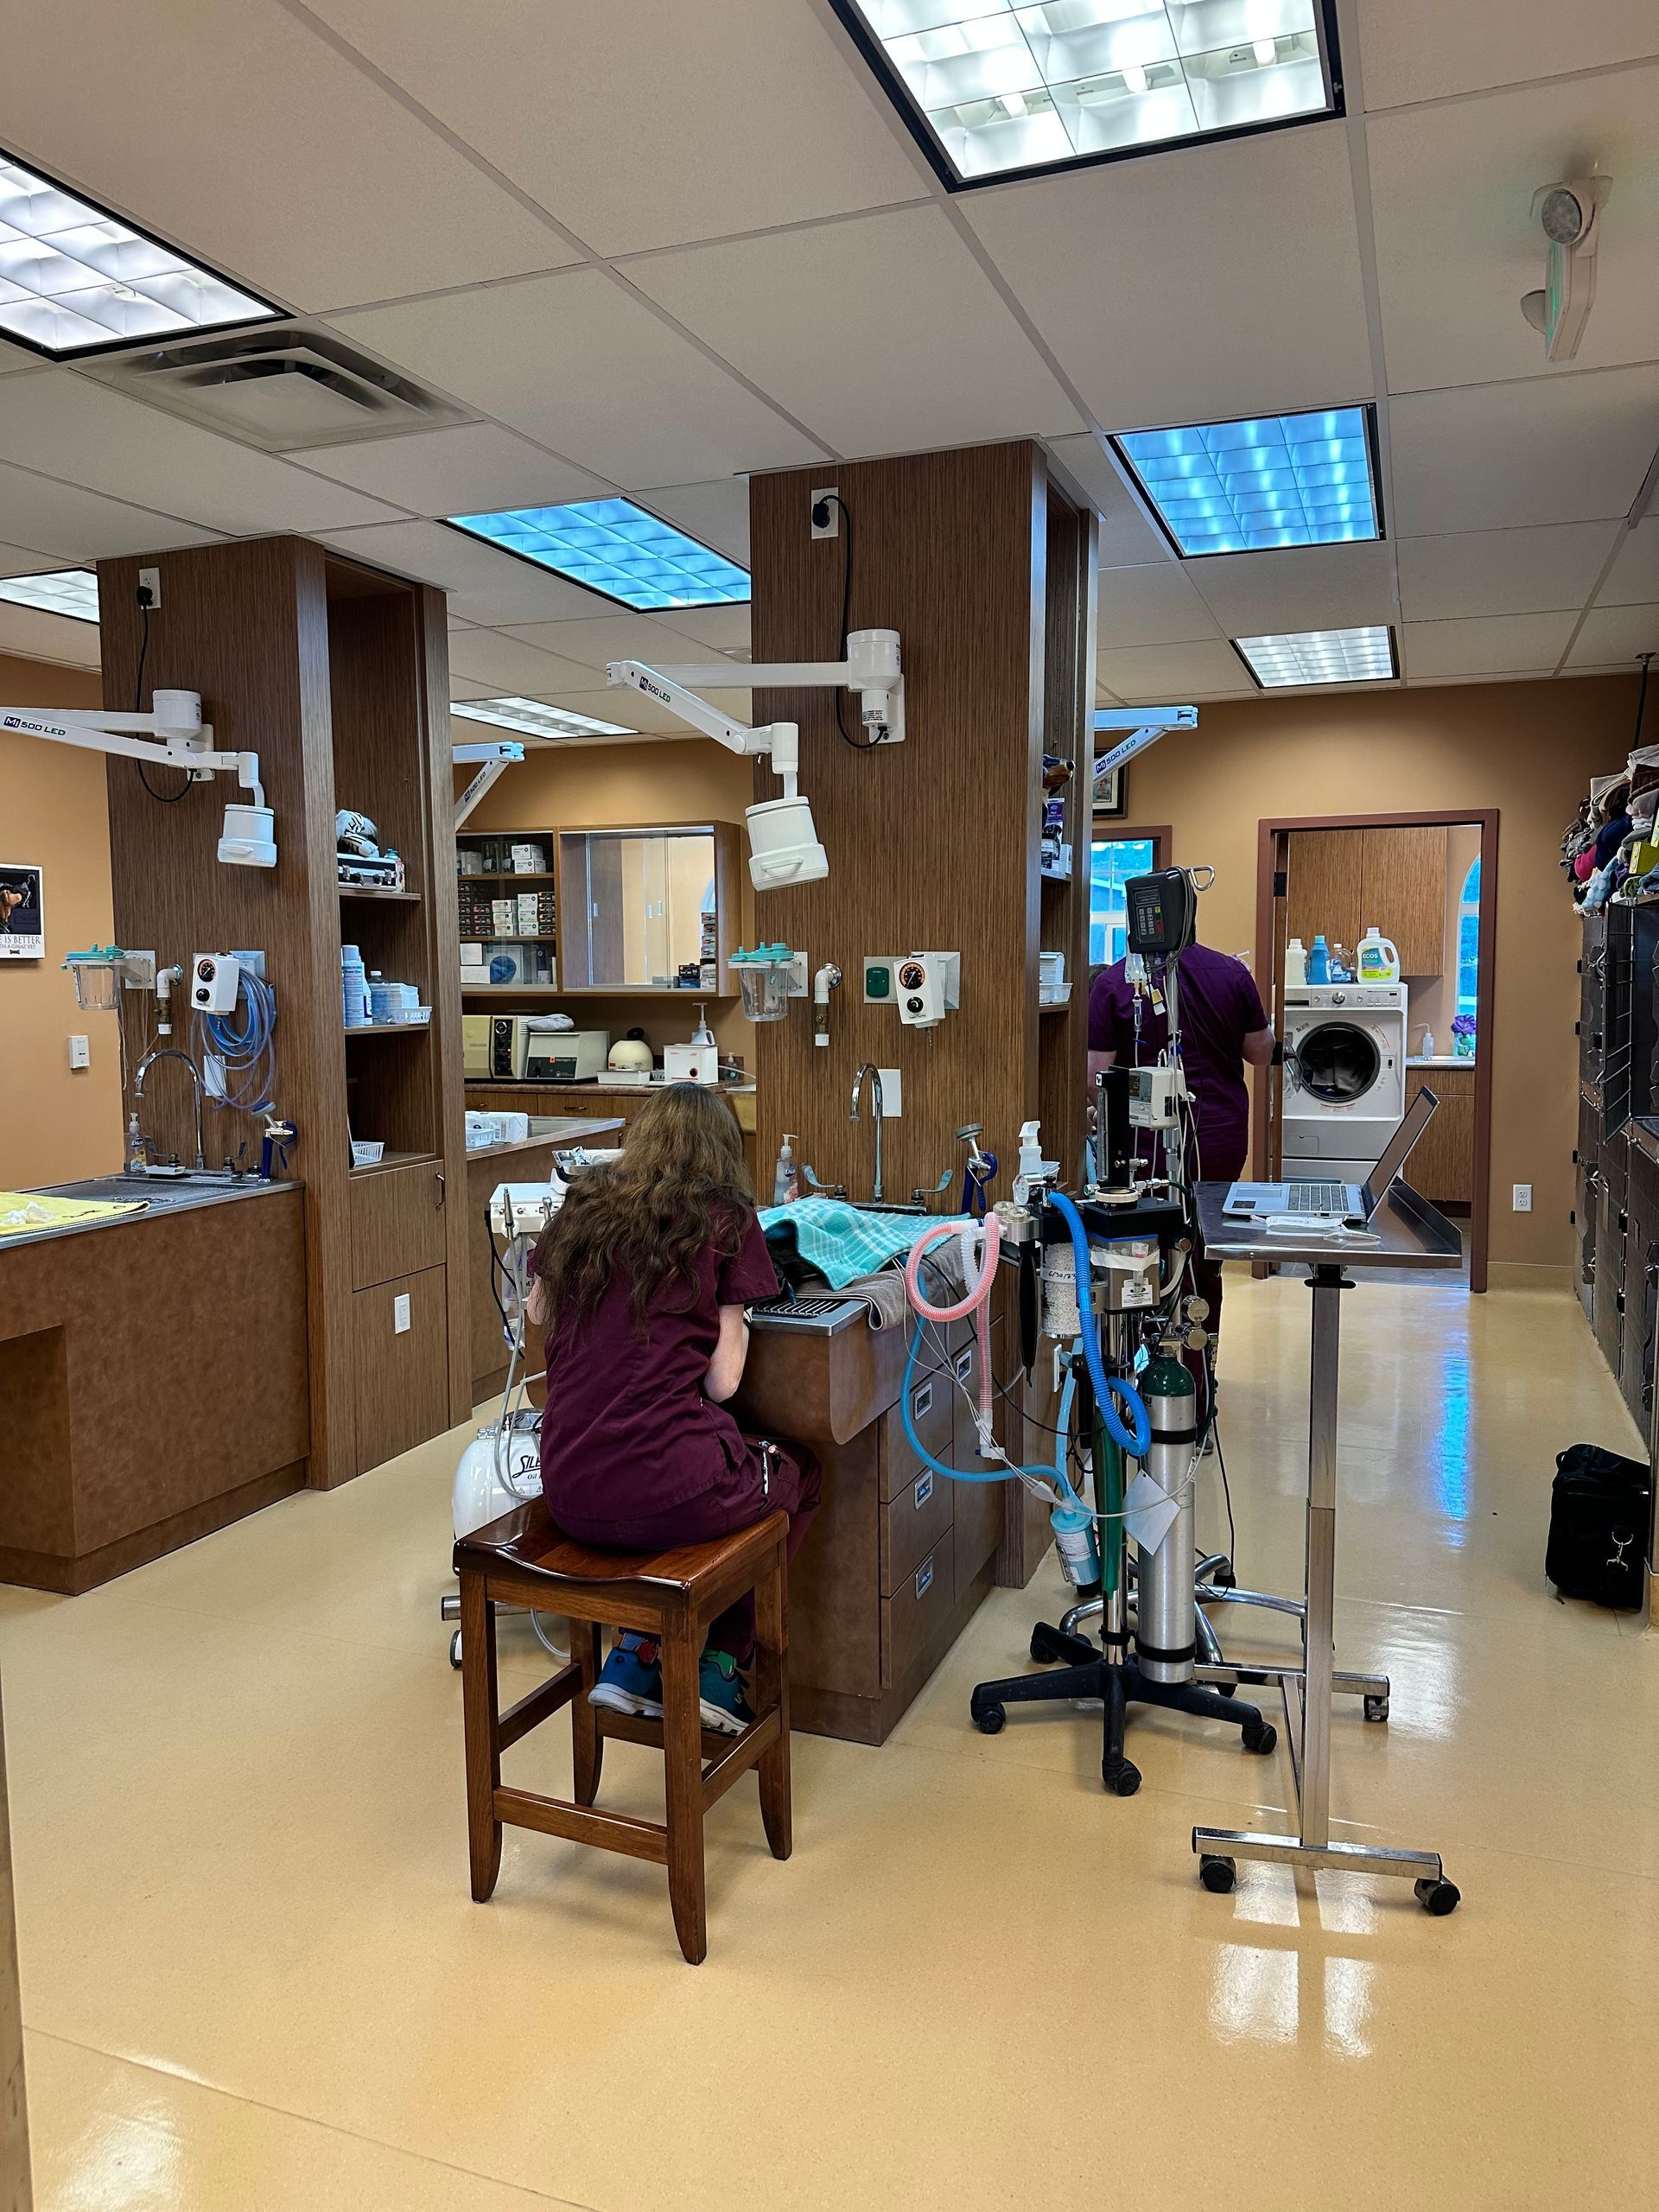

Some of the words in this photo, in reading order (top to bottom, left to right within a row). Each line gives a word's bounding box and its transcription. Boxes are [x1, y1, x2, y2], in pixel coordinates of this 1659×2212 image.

[647, 683, 658, 695] 500
[659, 690, 671, 702] LED
[21, 721, 42, 731] 500
[44, 727, 66, 735] LED
[1106, 751, 1121, 764] 500
[1121, 740, 1136, 753] LED
